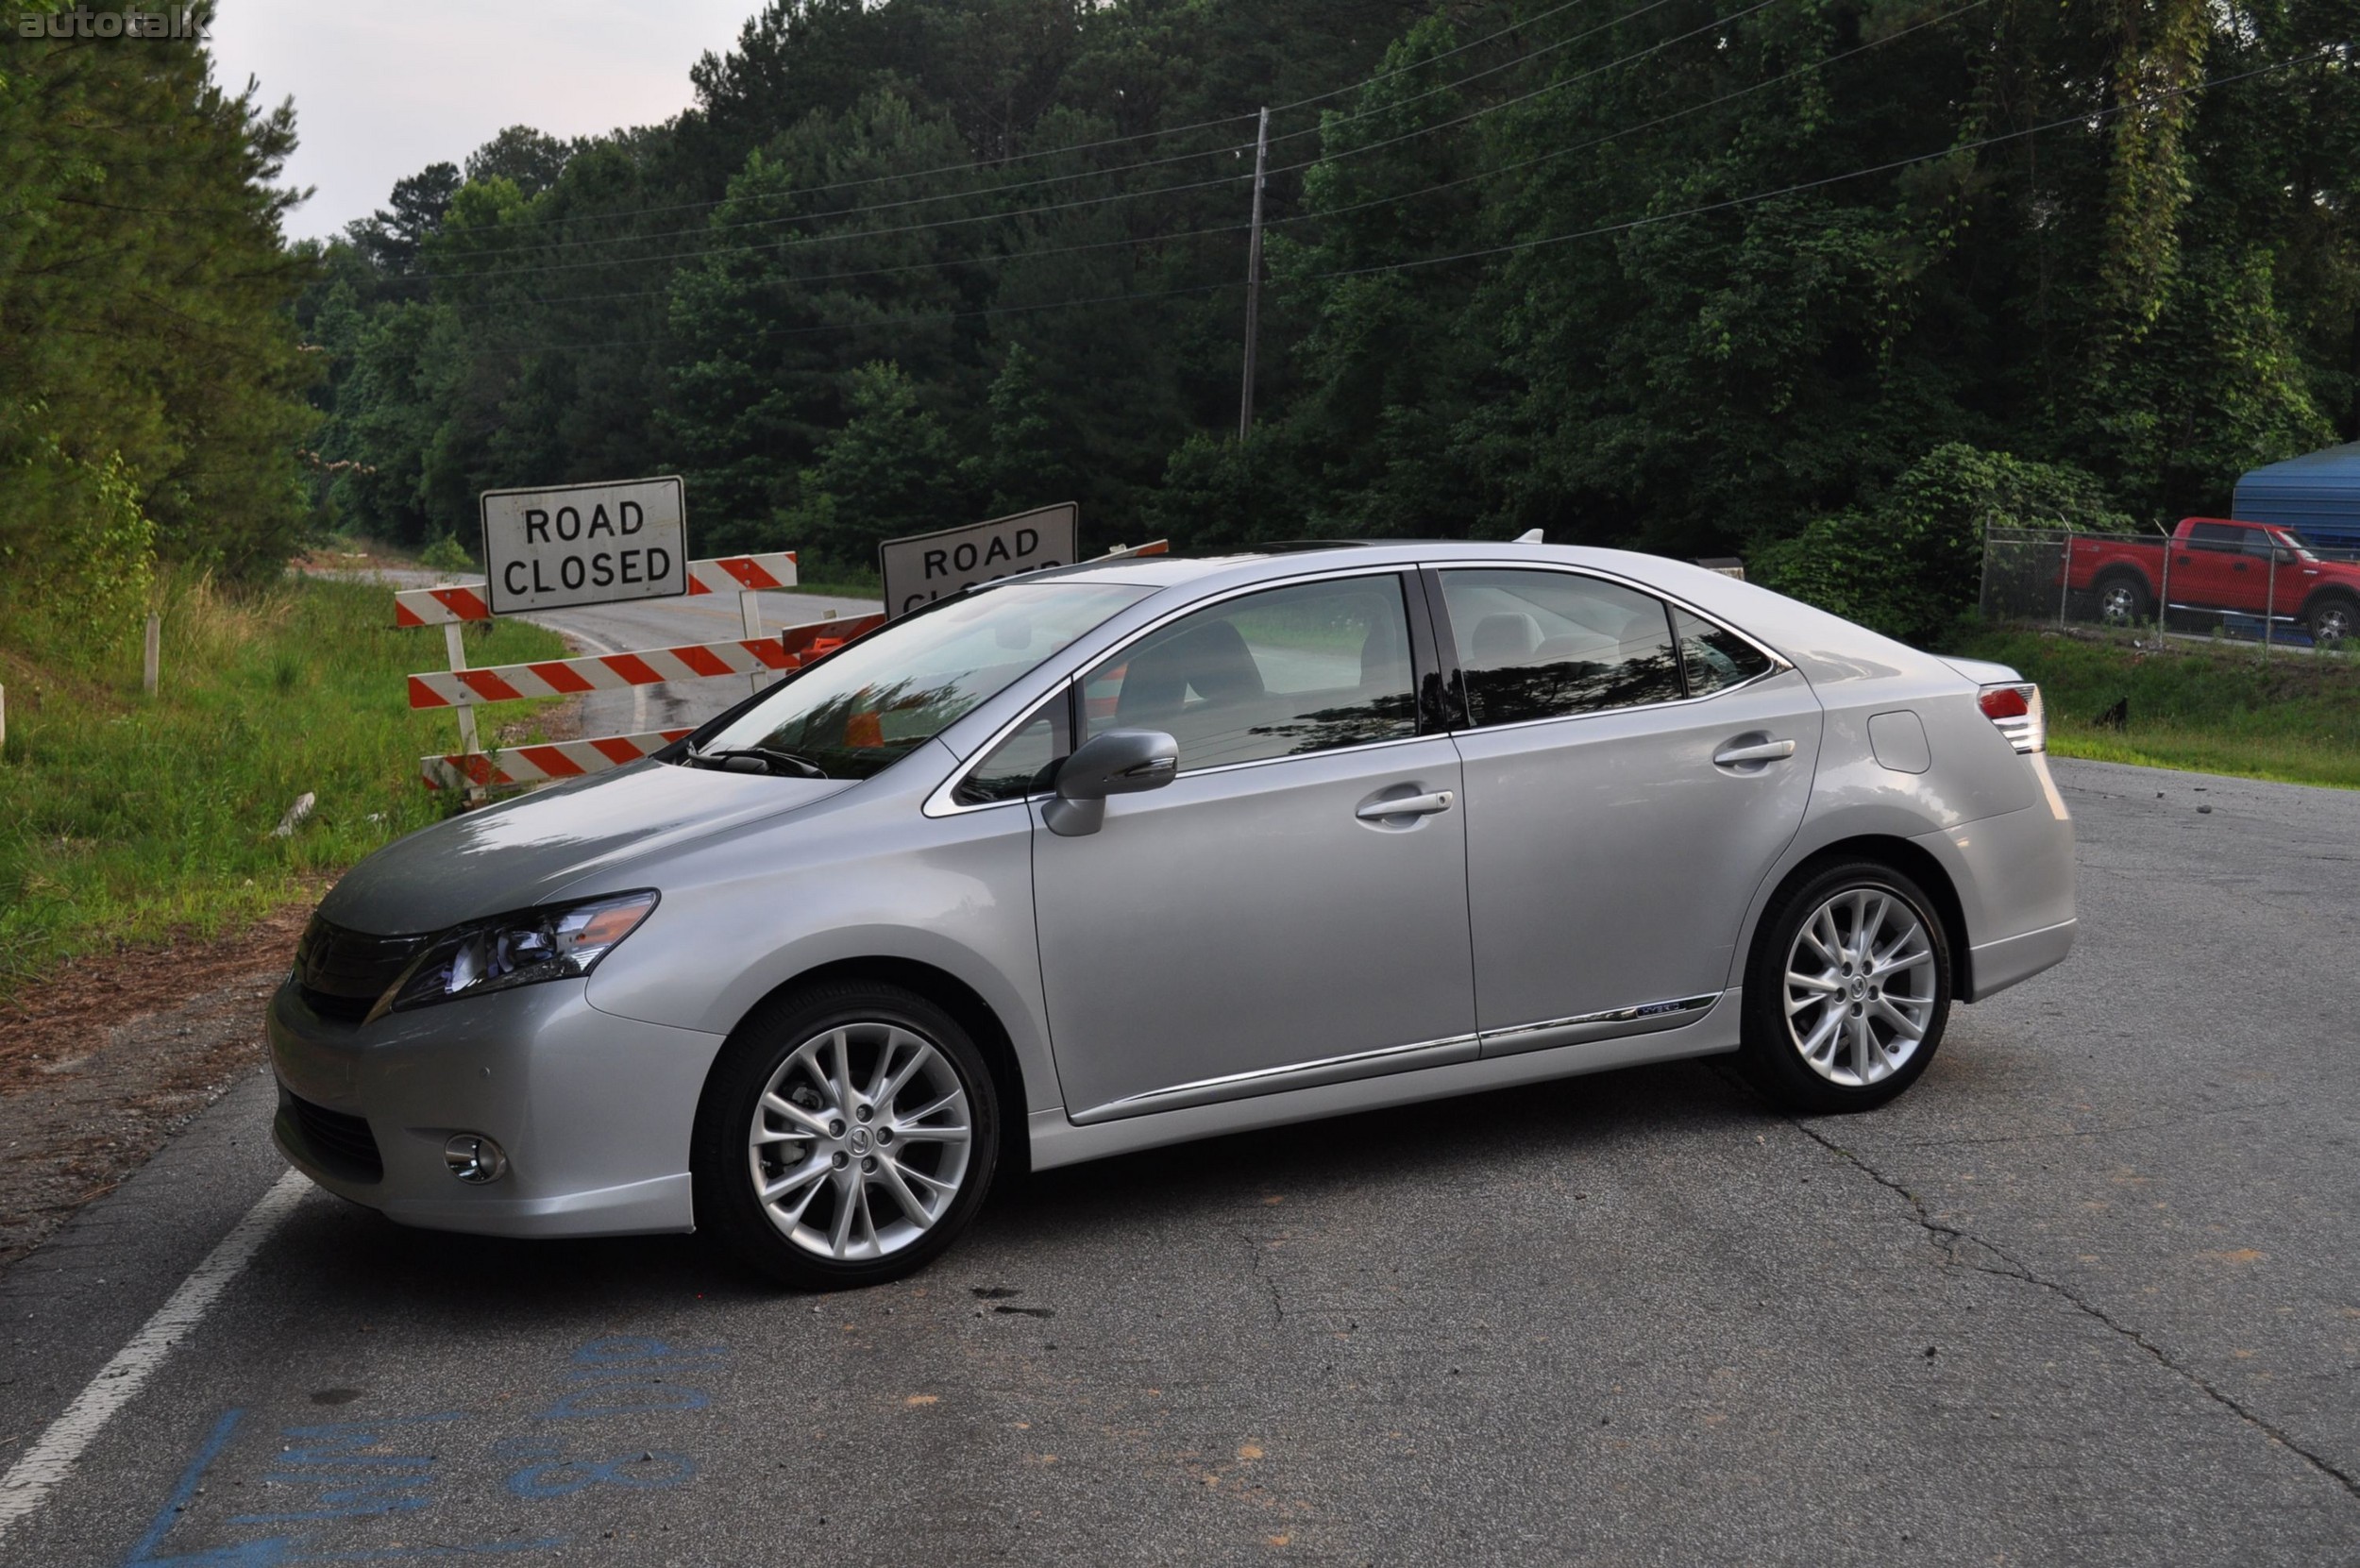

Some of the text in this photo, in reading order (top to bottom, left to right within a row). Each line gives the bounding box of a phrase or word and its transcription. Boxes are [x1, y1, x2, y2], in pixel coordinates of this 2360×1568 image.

[525, 500, 644, 545] ROAD
[504, 548, 670, 596] CLOSED
[923, 528, 1039, 579] ROAD
